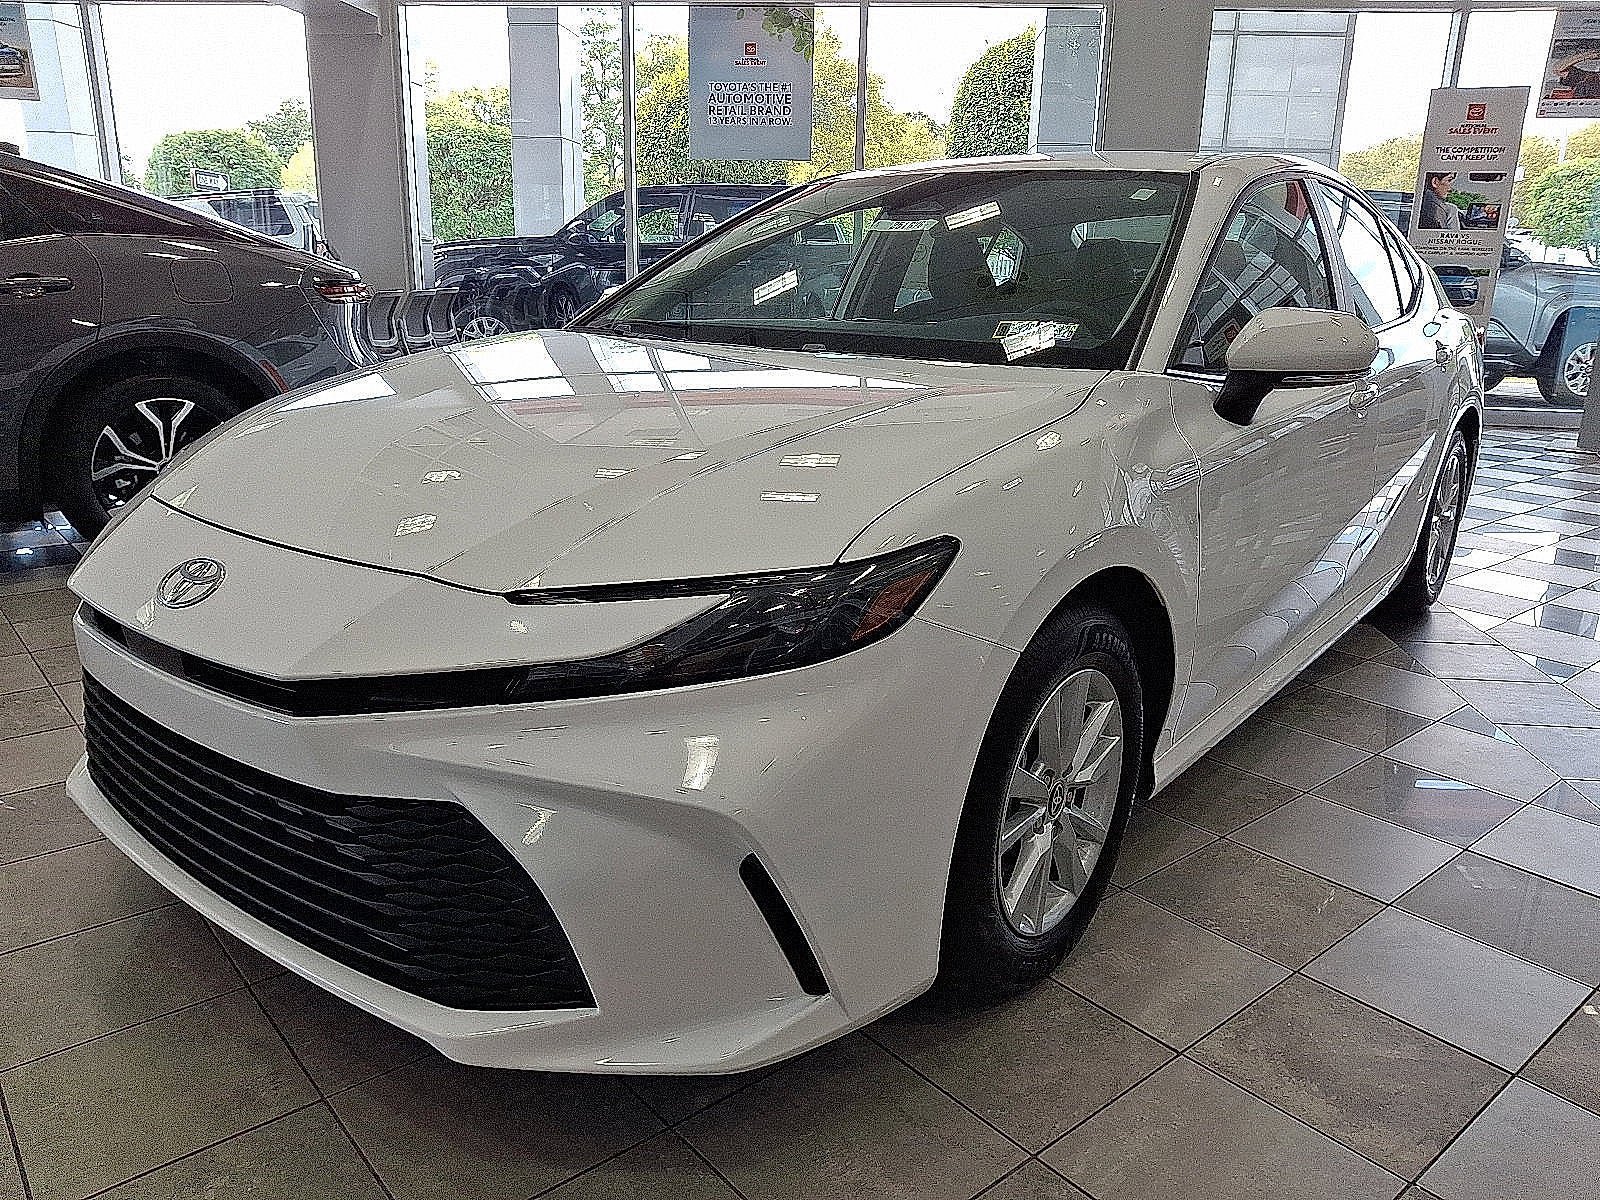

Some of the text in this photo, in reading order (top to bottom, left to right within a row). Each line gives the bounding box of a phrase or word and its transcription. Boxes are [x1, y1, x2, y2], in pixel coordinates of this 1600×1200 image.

[708, 82, 792, 93] TOYOTA'S THE #1
[708, 93, 792, 105] AUTOMOTIVE
[708, 105, 792, 116] RETAIL BRAND
[708, 116, 718, 125] 13
[719, 116, 747, 125] YEARS
[749, 117, 759, 126] IN
[759, 117, 767, 126] A
[1447, 127, 1500, 135] SALES EVENT
[1435, 146, 1506, 154] THE COMPETITION
